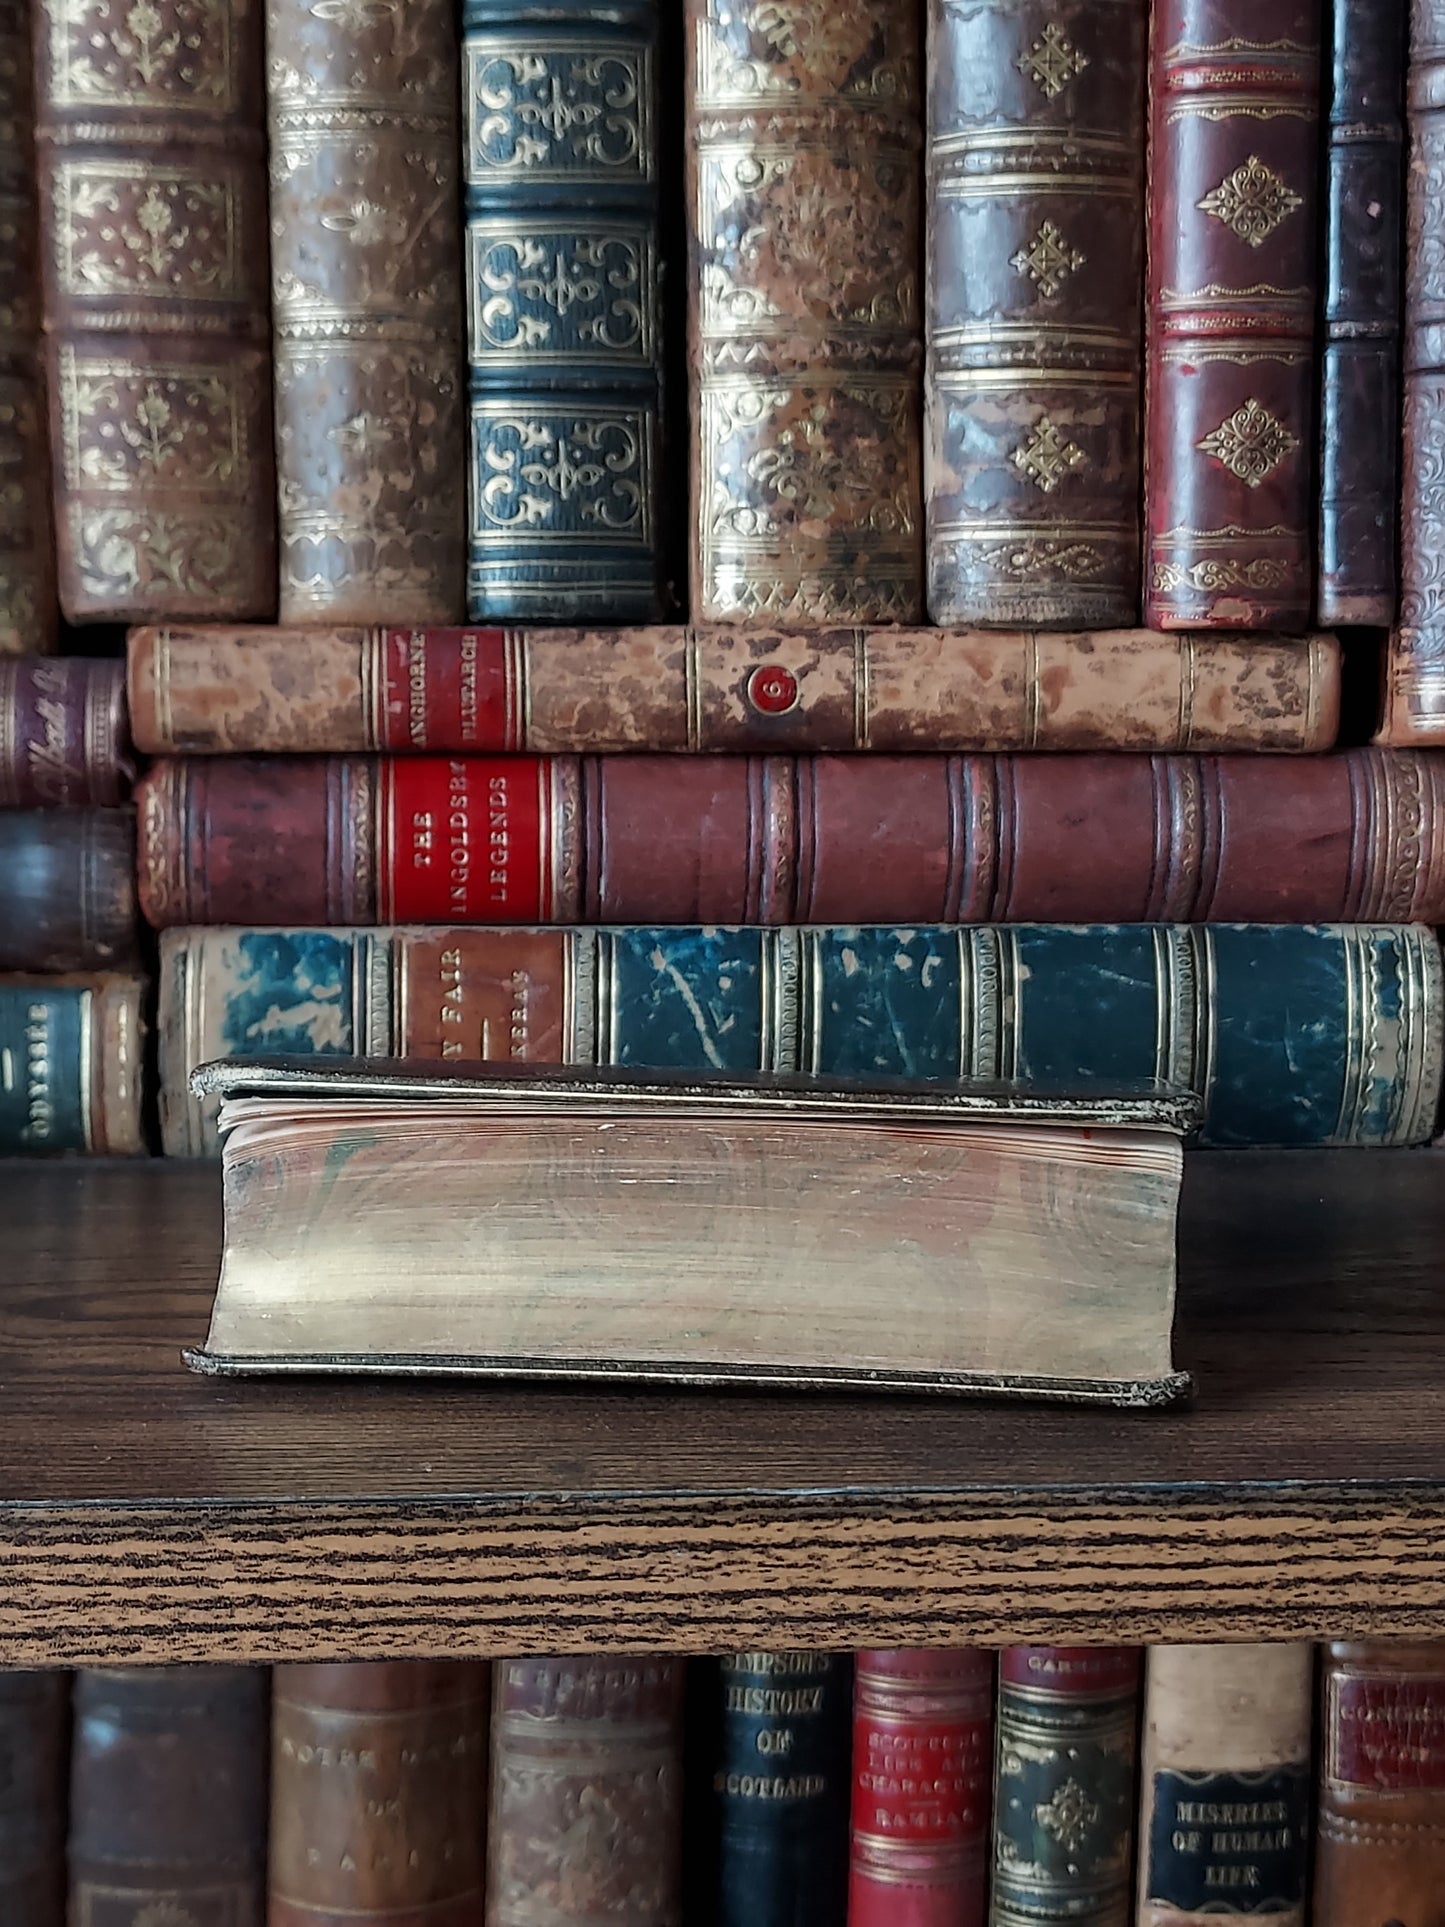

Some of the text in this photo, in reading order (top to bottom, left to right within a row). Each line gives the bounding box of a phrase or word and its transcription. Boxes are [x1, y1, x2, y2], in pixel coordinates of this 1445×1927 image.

[461, 634, 478, 741] PLUTARCH
[413, 812, 433, 869] THE
[449, 760, 469, 915] INGOLDSBY
[489, 775, 510, 903] LEGENDS
[440, 947, 464, 1025] FAIR
[726, 1686, 825, 1714] HISTORY
[1176, 1800, 1289, 1824] MISERIES
[1212, 1827, 1292, 1853] HUMAN
